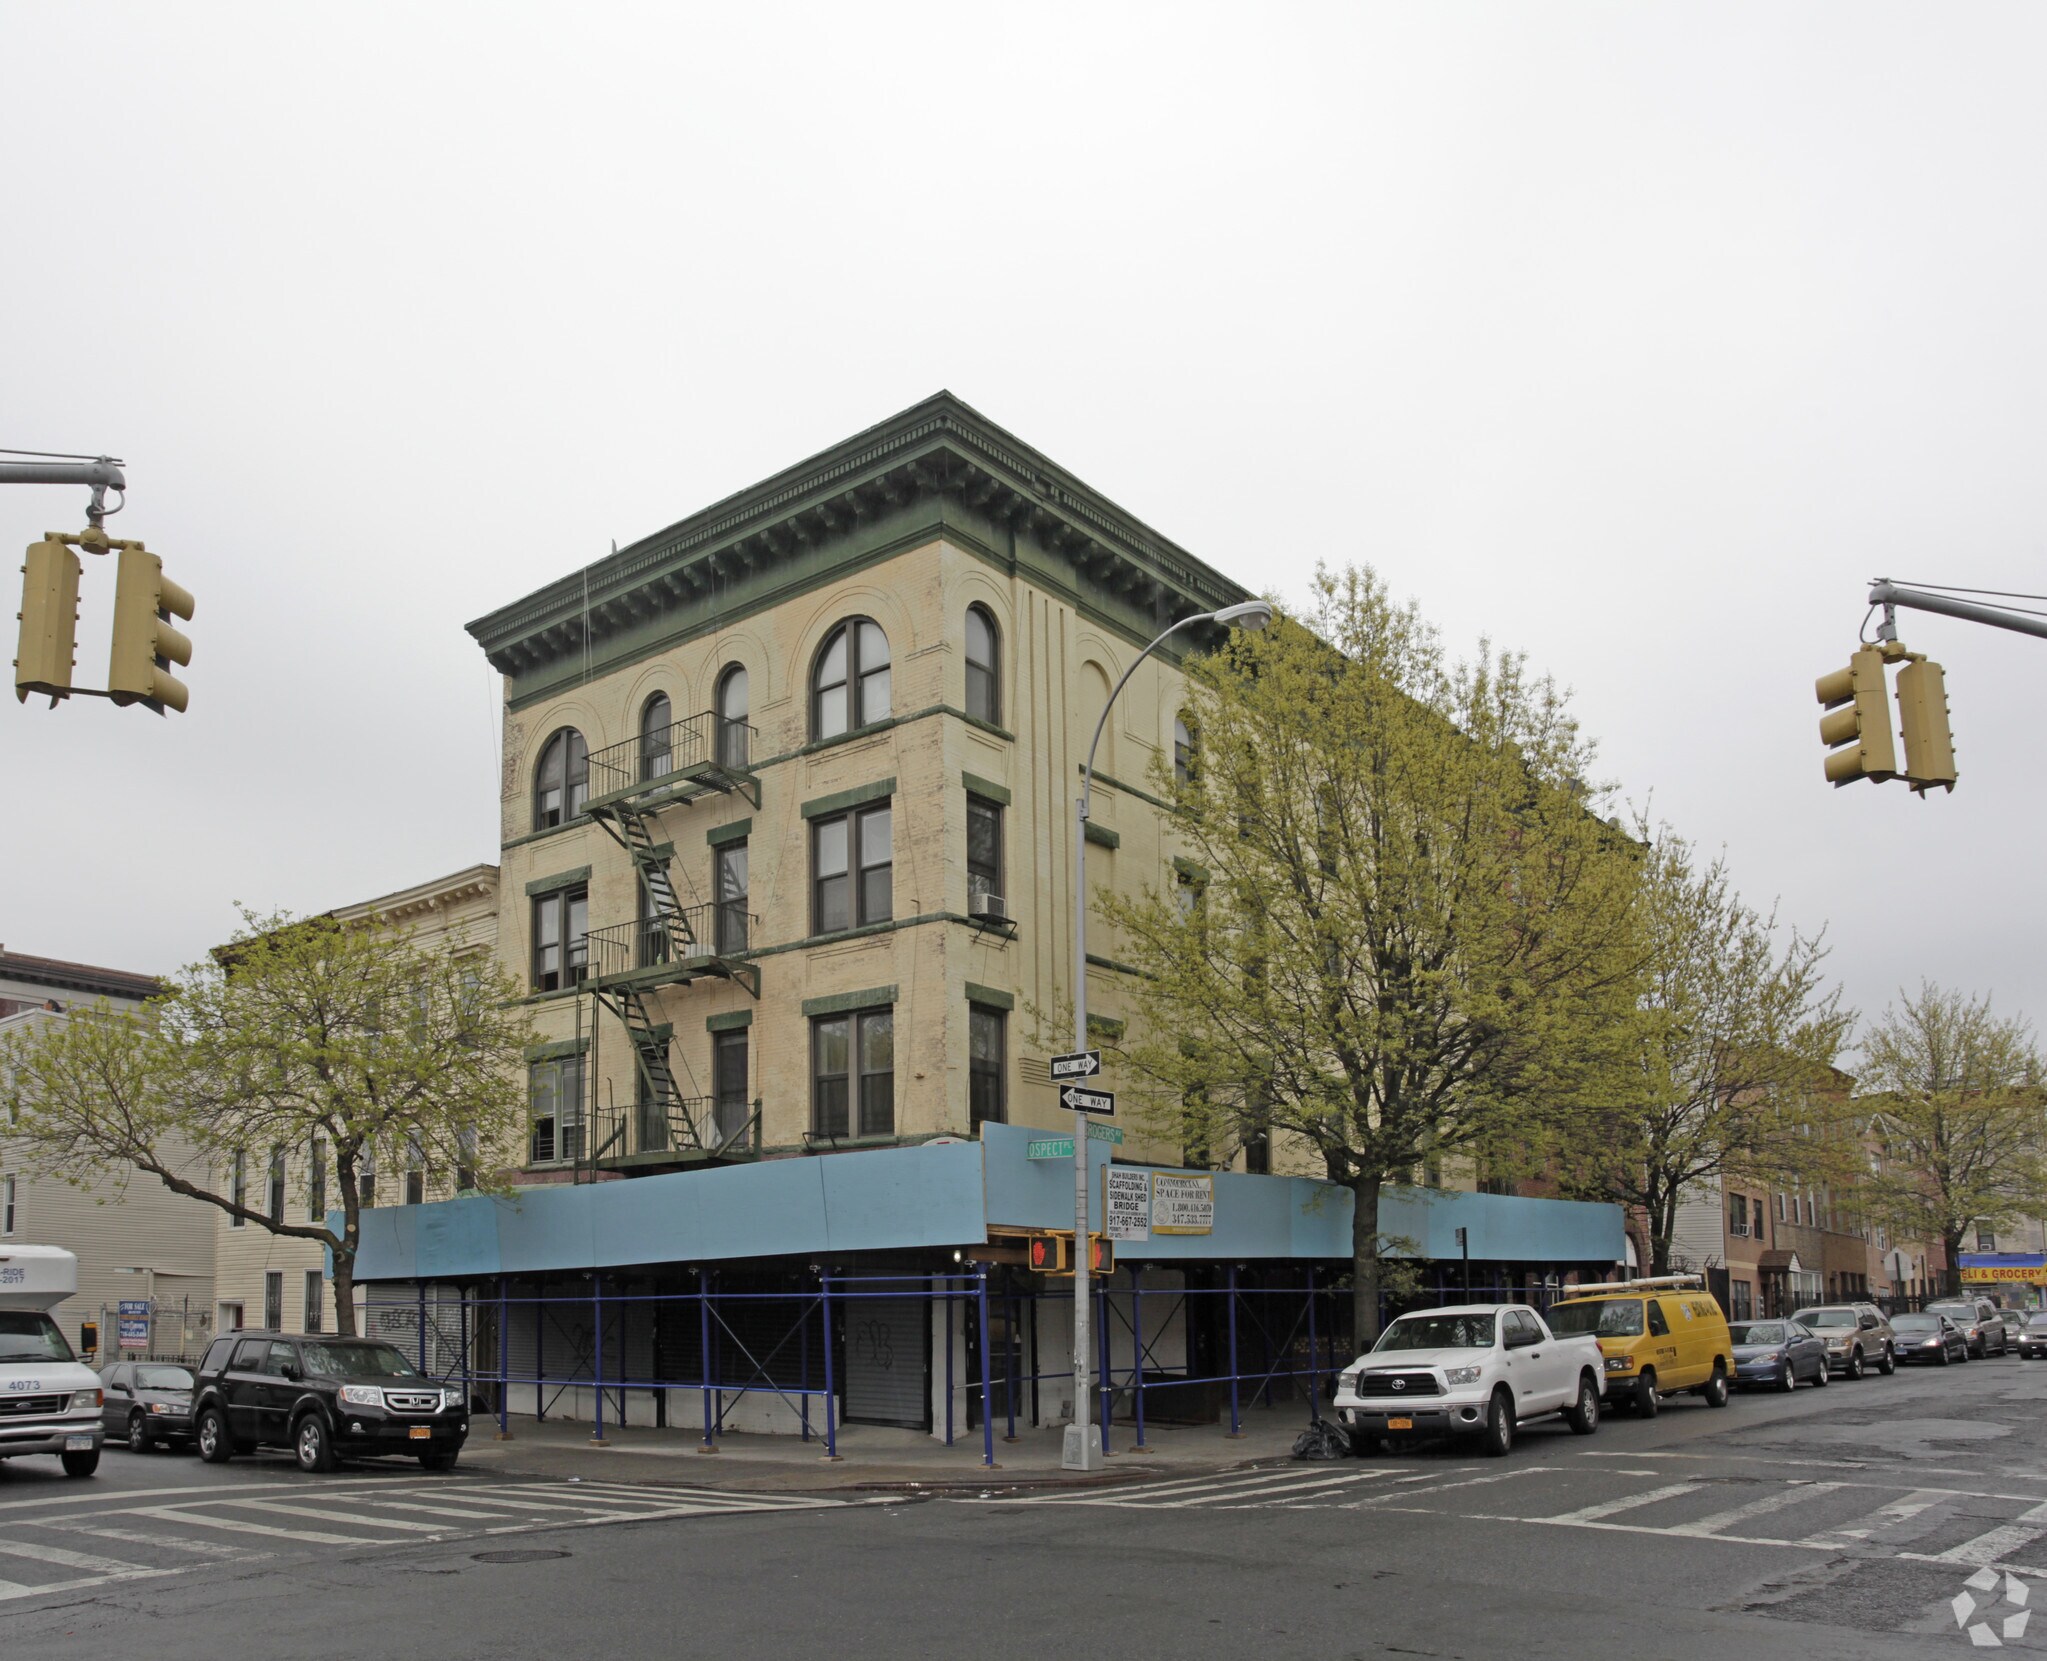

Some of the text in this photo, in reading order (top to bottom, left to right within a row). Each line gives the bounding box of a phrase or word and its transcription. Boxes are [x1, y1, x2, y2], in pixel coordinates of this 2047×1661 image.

[1058, 1060, 1092, 1073] ONE WAY
[1068, 1093, 1107, 1108] ONE WAY
[1087, 1123, 1115, 1142] ROGERS
[1029, 1142, 1063, 1157] OSPECT
[1109, 1179, 1148, 1192] SCAFFOLDING &
[1109, 1191, 1147, 1203] SIDEWALK SHED
[1156, 1188, 1179, 1199] SPACE
[1180, 1190, 1195, 1200] FOR
[1114, 1201, 1139, 1211] BRIDGE
[1108, 1215, 1148, 1228] 917-667-2552
[1981, 1269, 1988, 1279] &
[1991, 1269, 2042, 1279] GROCERY
[9, 1380, 41, 1391] 4073
